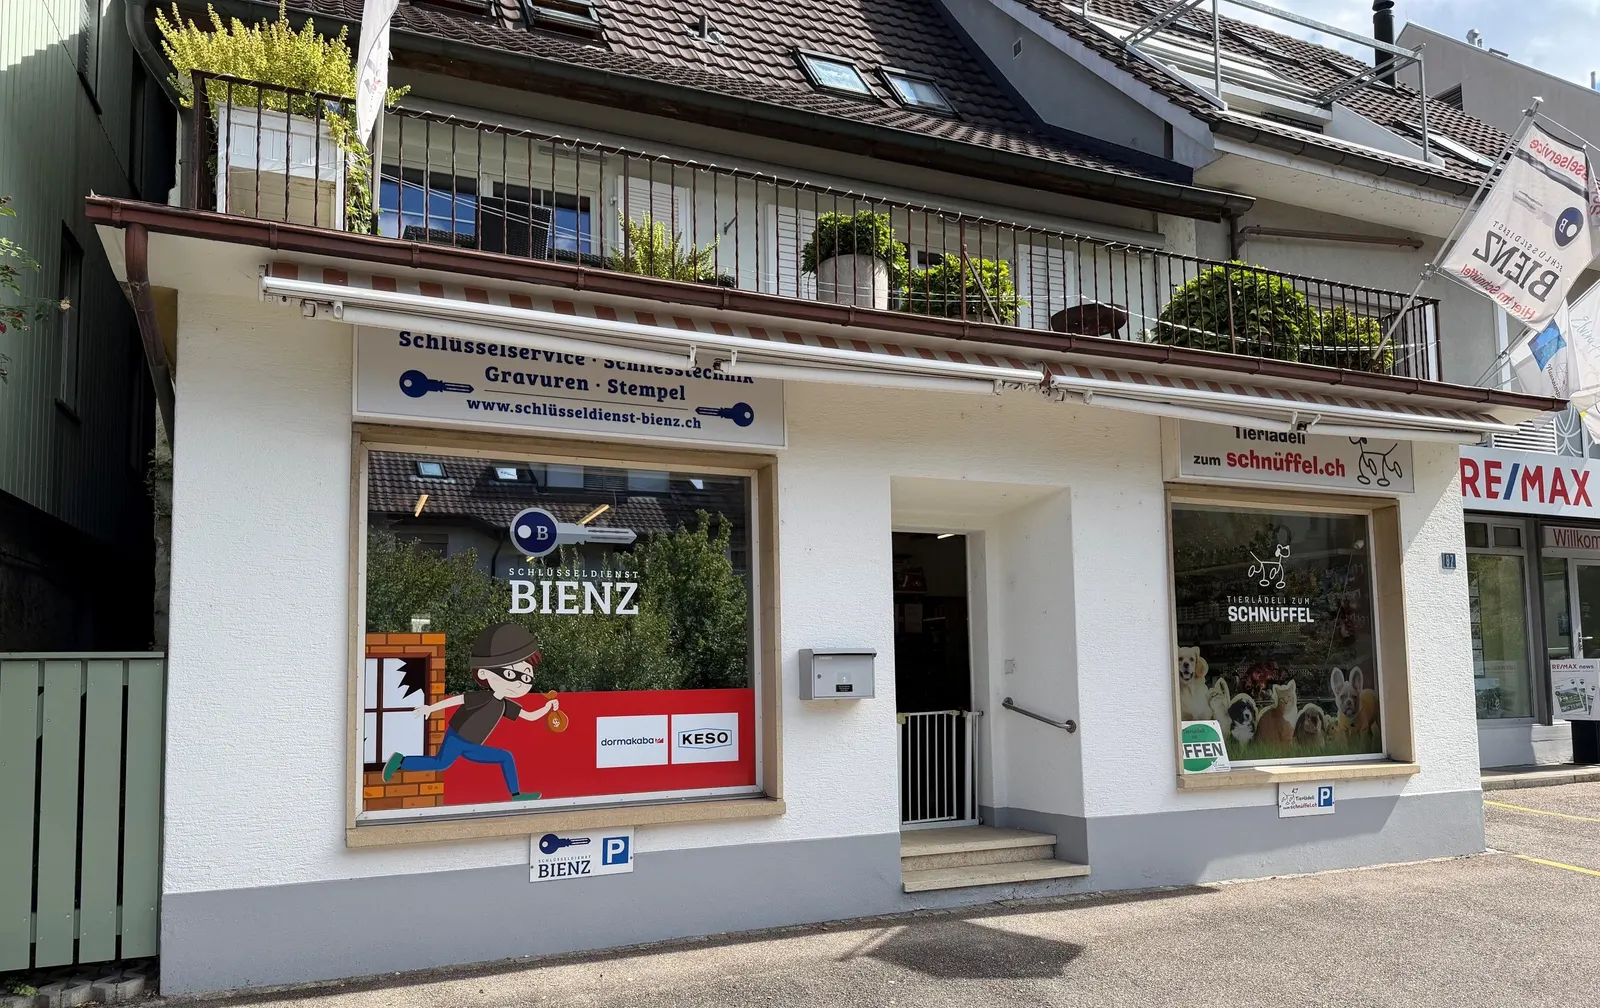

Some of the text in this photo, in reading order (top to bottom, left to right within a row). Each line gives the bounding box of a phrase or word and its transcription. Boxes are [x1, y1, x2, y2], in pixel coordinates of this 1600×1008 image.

[485, 366, 686, 402] Gravuren Stempel
[466, 399, 701, 429] www.schlüsseldienst-bienz.ch
[1193, 449, 1346, 477] zum schnüffel.ch
[1459, 458, 1593, 507] RE/MAX
[536, 526, 549, 541] B
[509, 567, 639, 579] SCHLÜSSELDIENST
[509, 580, 639, 615] BIENZ
[1291, 597, 1310, 605] ZUM
[1228, 606, 1315, 623] SCHNÜFFEL
[601, 736, 654, 746] dormakaba
[682, 732, 728, 745] KESO
[1182, 742, 1224, 758] FFEN
[1320, 787, 1331, 806] P
[606, 839, 625, 864] P
[538, 860, 591, 879] BIENZ
